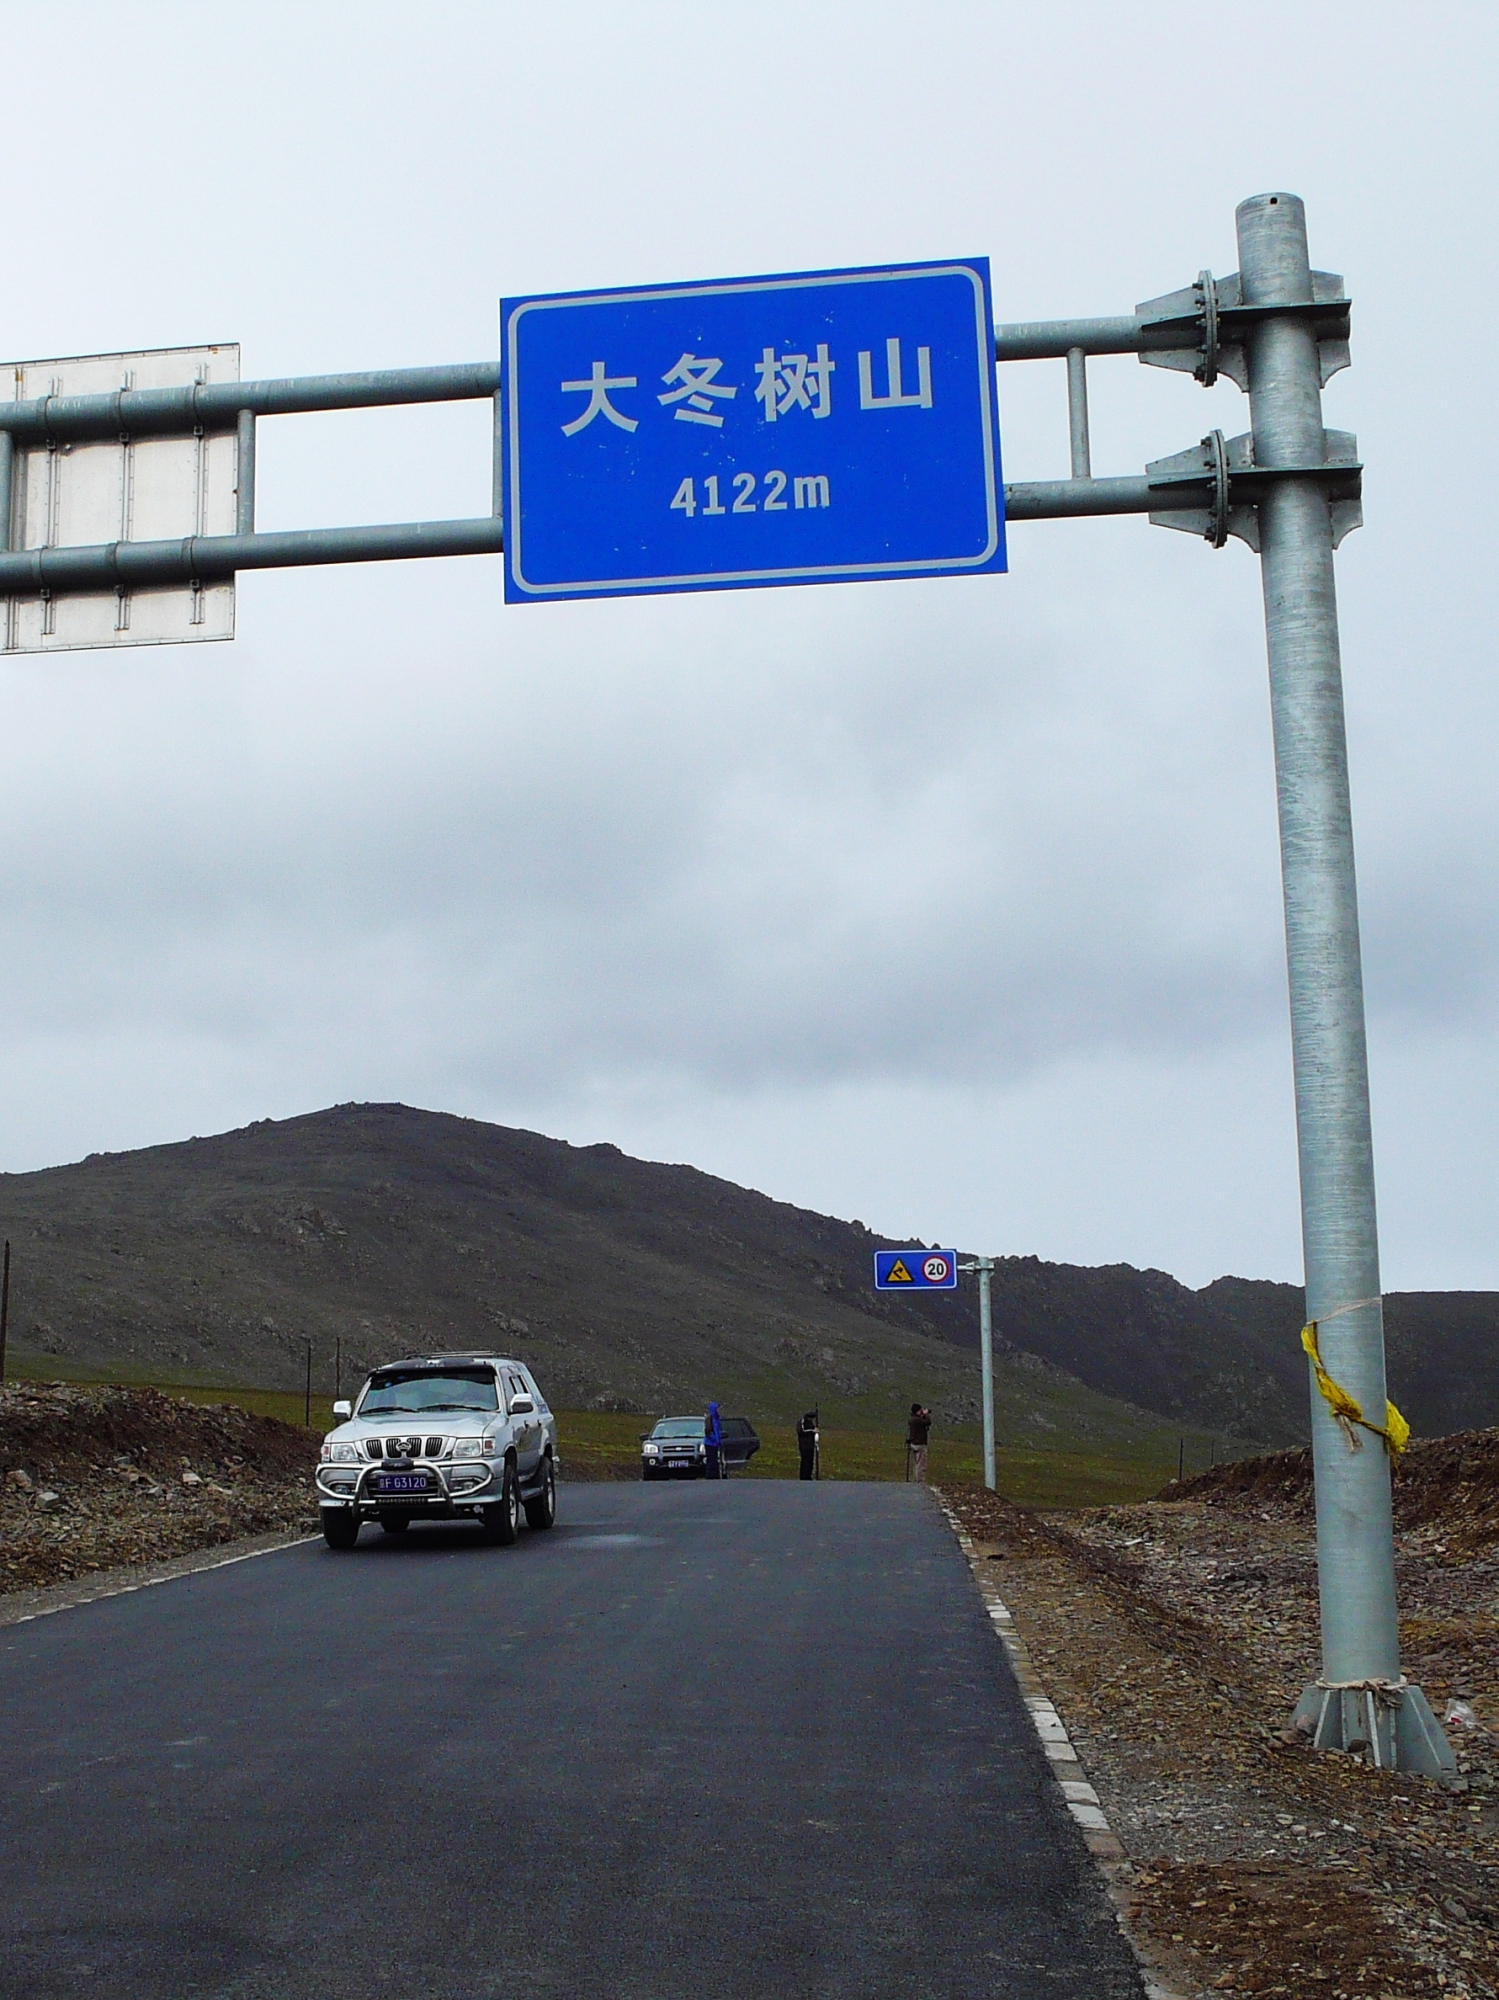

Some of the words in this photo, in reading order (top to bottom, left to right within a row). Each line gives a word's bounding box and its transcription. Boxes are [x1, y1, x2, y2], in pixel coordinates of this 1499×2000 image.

[561, 338, 933, 435] 大冬树山
[670, 470, 830, 517] 4122m
[927, 1263, 944, 1276] 20
